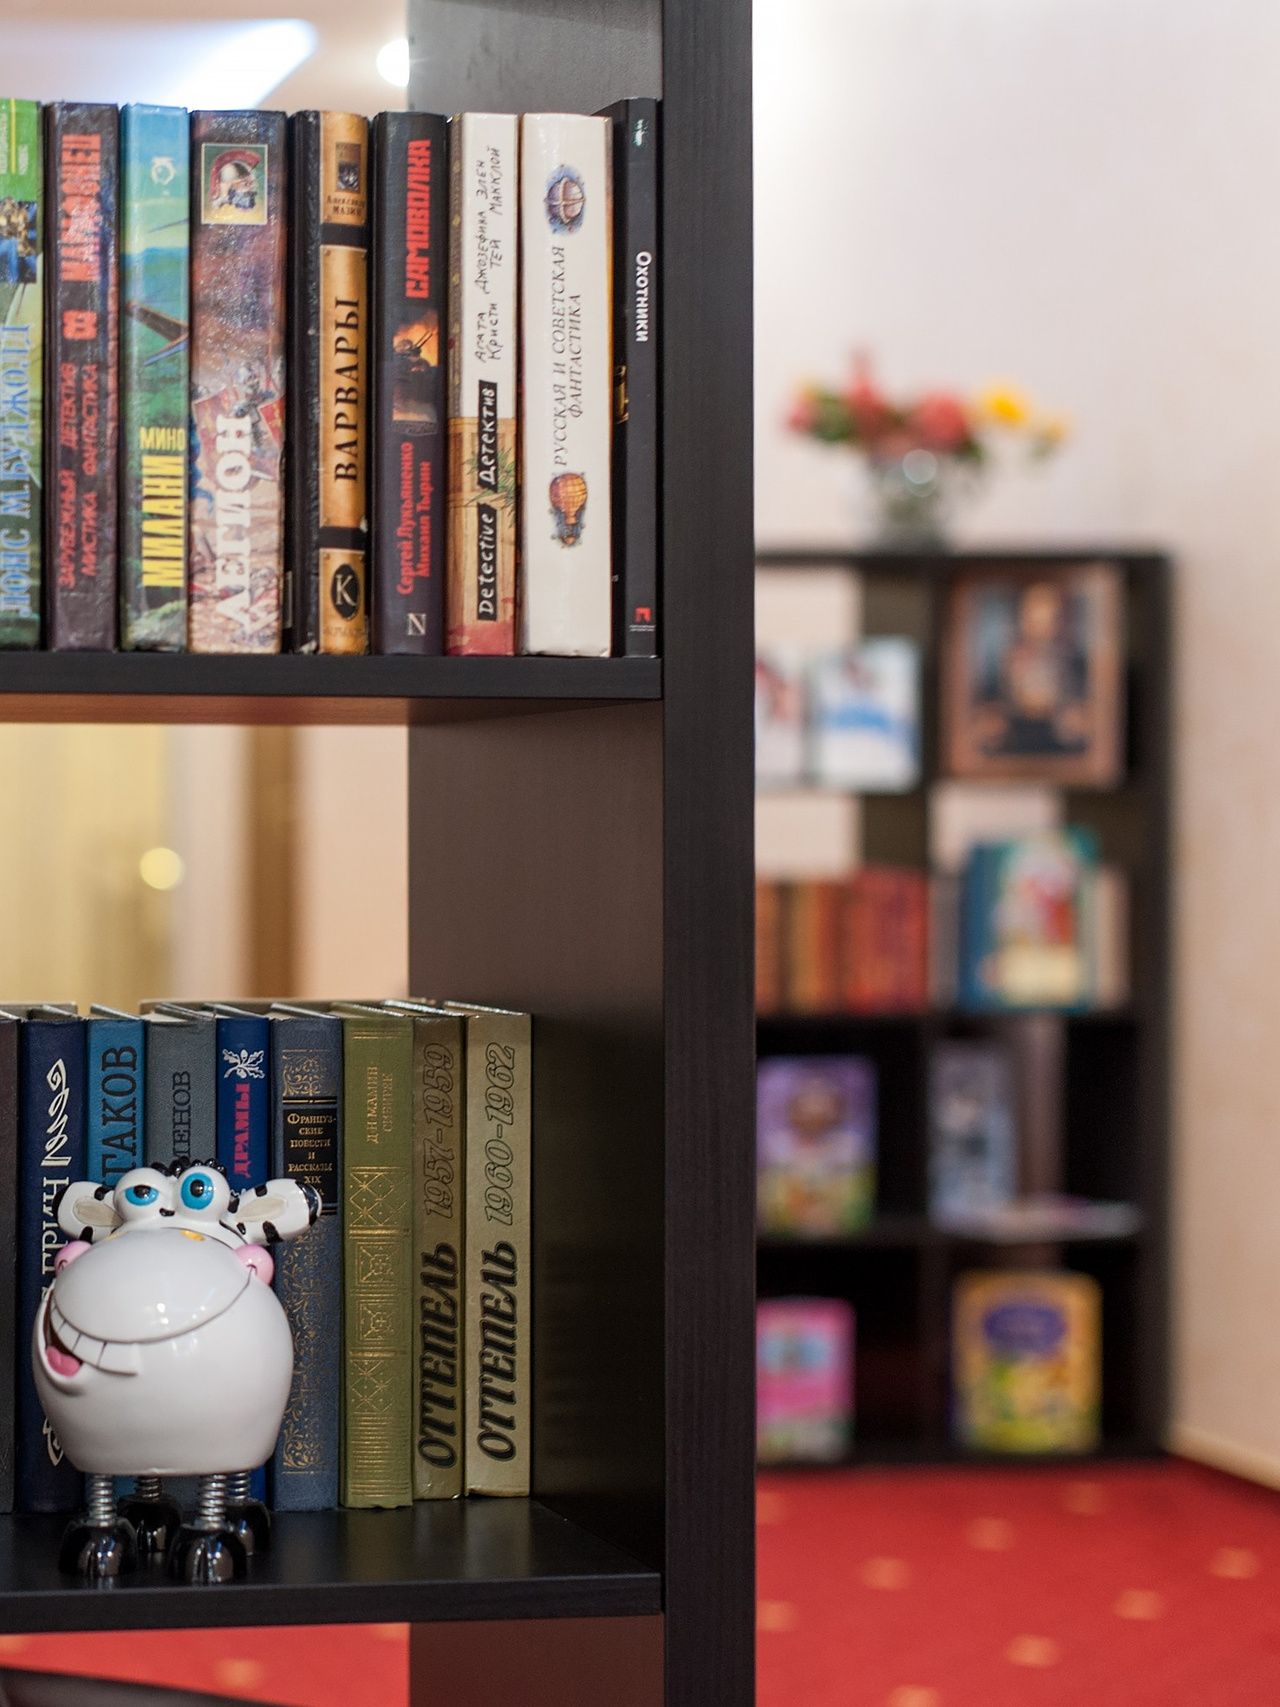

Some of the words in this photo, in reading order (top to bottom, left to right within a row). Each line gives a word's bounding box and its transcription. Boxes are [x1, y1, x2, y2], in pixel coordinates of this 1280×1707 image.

[61, 134, 101, 281] МАРАФОНЕЦ
[405, 139, 431, 298] САМОВОЛКА
[551, 246, 566, 355] СОВЕТСКАЯ
[635, 251, 652, 343] ОХОТНИКИ
[334, 297, 358, 481] ВАРВАРЫ
[553, 363, 566, 376] И
[569, 294, 582, 418] ФАНТАСТИКА
[60, 363, 78, 449] ДЕТЕКТИВ
[81, 364, 99, 475] ФАНТАСТИКА
[140, 427, 186, 450] МИНО
[479, 387, 496, 486] Детектив
[552, 384, 568, 466] РУССКАЯ
[81, 492, 98, 577] МИСТИКА
[142, 455, 185, 586] МИЛАНИ
[215, 415, 251, 627] ЛЕГИОН
[397, 442, 416, 538] Лукьяненко
[416, 461, 433, 512] Тырин
[0, 528, 31, 617] ЛОИС
[397, 540, 416, 594] Сергей
[416, 515, 430, 577] Михаил
[478, 513, 495, 615] Detective
[101, 1046, 138, 1188] ГАКОВ
[233, 1083, 251, 1178] ДРАМЫ
[290, 1139, 331, 1148] ПОВЕСТИ
[299, 1127, 323, 1135] СКИЕ
[308, 1151, 316, 1160] И
[423, 1043, 454, 1219] 1957-1959
[484, 1043, 515, 1226] 1960-1962
[288, 1163, 333, 1172] РАССКАЗЫ
[418, 1242, 458, 1469] ОТТЕПЕЛЬ
[477, 1240, 518, 1462] ОТТЕПЕЛЬ
